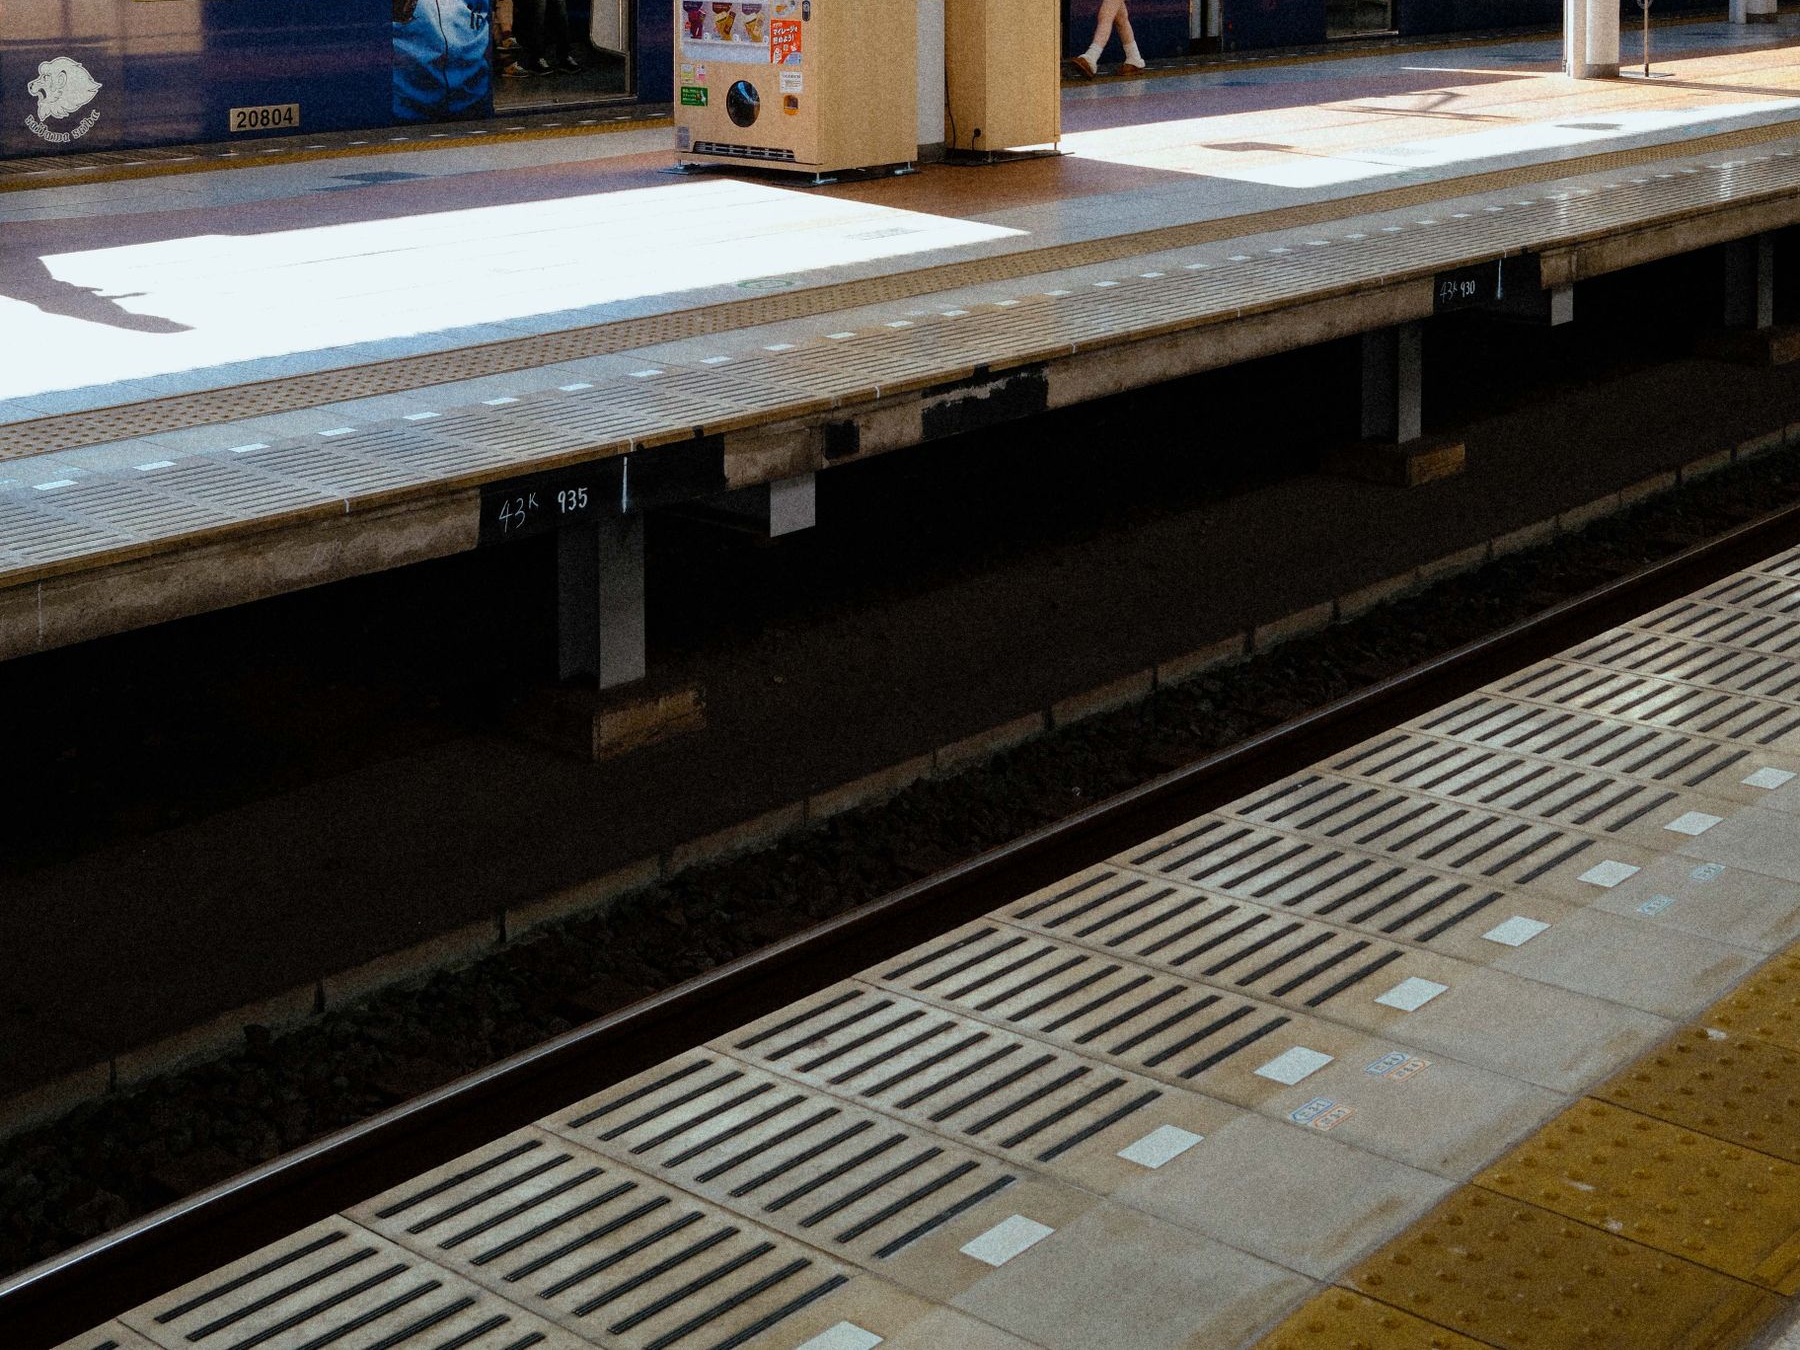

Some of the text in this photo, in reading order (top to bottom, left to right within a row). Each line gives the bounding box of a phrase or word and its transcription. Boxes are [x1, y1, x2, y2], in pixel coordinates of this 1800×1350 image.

[236, 106, 293, 128] 20804
[1460, 279, 1476, 298] 930
[557, 487, 588, 514] 935
